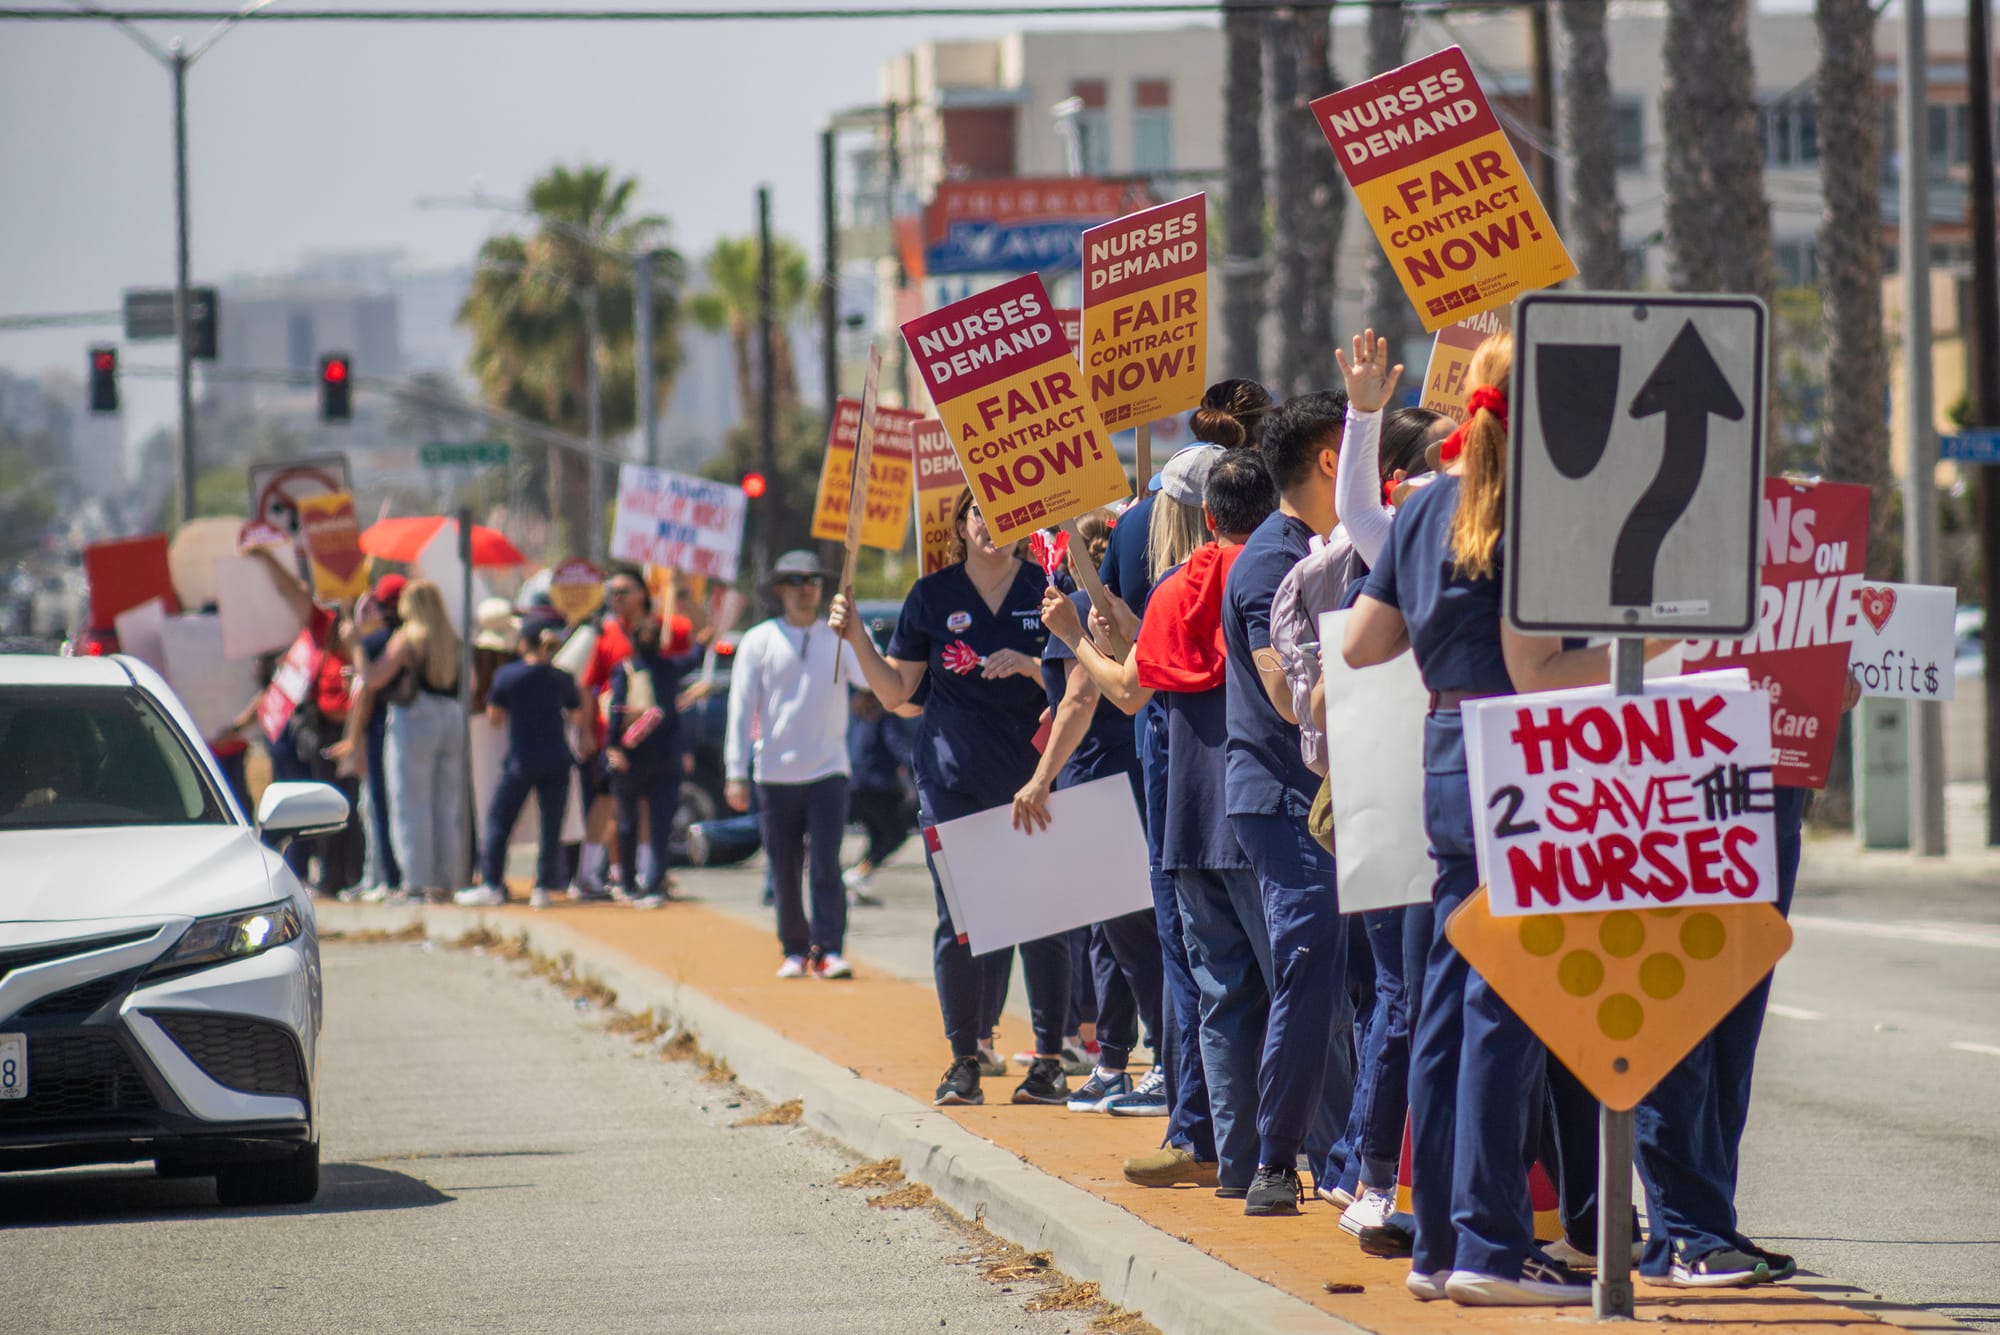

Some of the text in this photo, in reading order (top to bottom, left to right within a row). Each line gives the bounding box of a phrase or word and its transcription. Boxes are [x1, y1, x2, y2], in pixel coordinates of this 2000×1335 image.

[1330, 68, 1464, 137] NURSES
[1344, 99, 1478, 165] DEMAND
[1383, 150, 1510, 224] A FAIR
[1391, 185, 1520, 248] CONTRACT
[1091, 212, 1198, 265] NURSES
[1091, 241, 1198, 290] DEMAND
[1403, 210, 1542, 288] NOW!
[917, 293, 1041, 358] NURSES
[1090, 321, 1198, 367] CONTRACT
[1092, 328, 1106, 345] A
[1113, 287, 1197, 338] FAIR
[929, 323, 1052, 385] DEMAND
[1091, 344, 1197, 403] NOW!
[1432, 373, 1440, 392] A
[962, 371, 1078, 441] A FAIR
[967, 406, 1085, 465] CONTRACT
[977, 430, 1103, 503] NOW!
[1814, 541, 1847, 574] ON
[1023, 618, 1039, 630] RN
[1510, 694, 1739, 775] HONK
[1773, 707, 1818, 738] Care
[1487, 763, 1775, 838] 2 SAVE THE
[1507, 825, 1759, 908] NURSES
